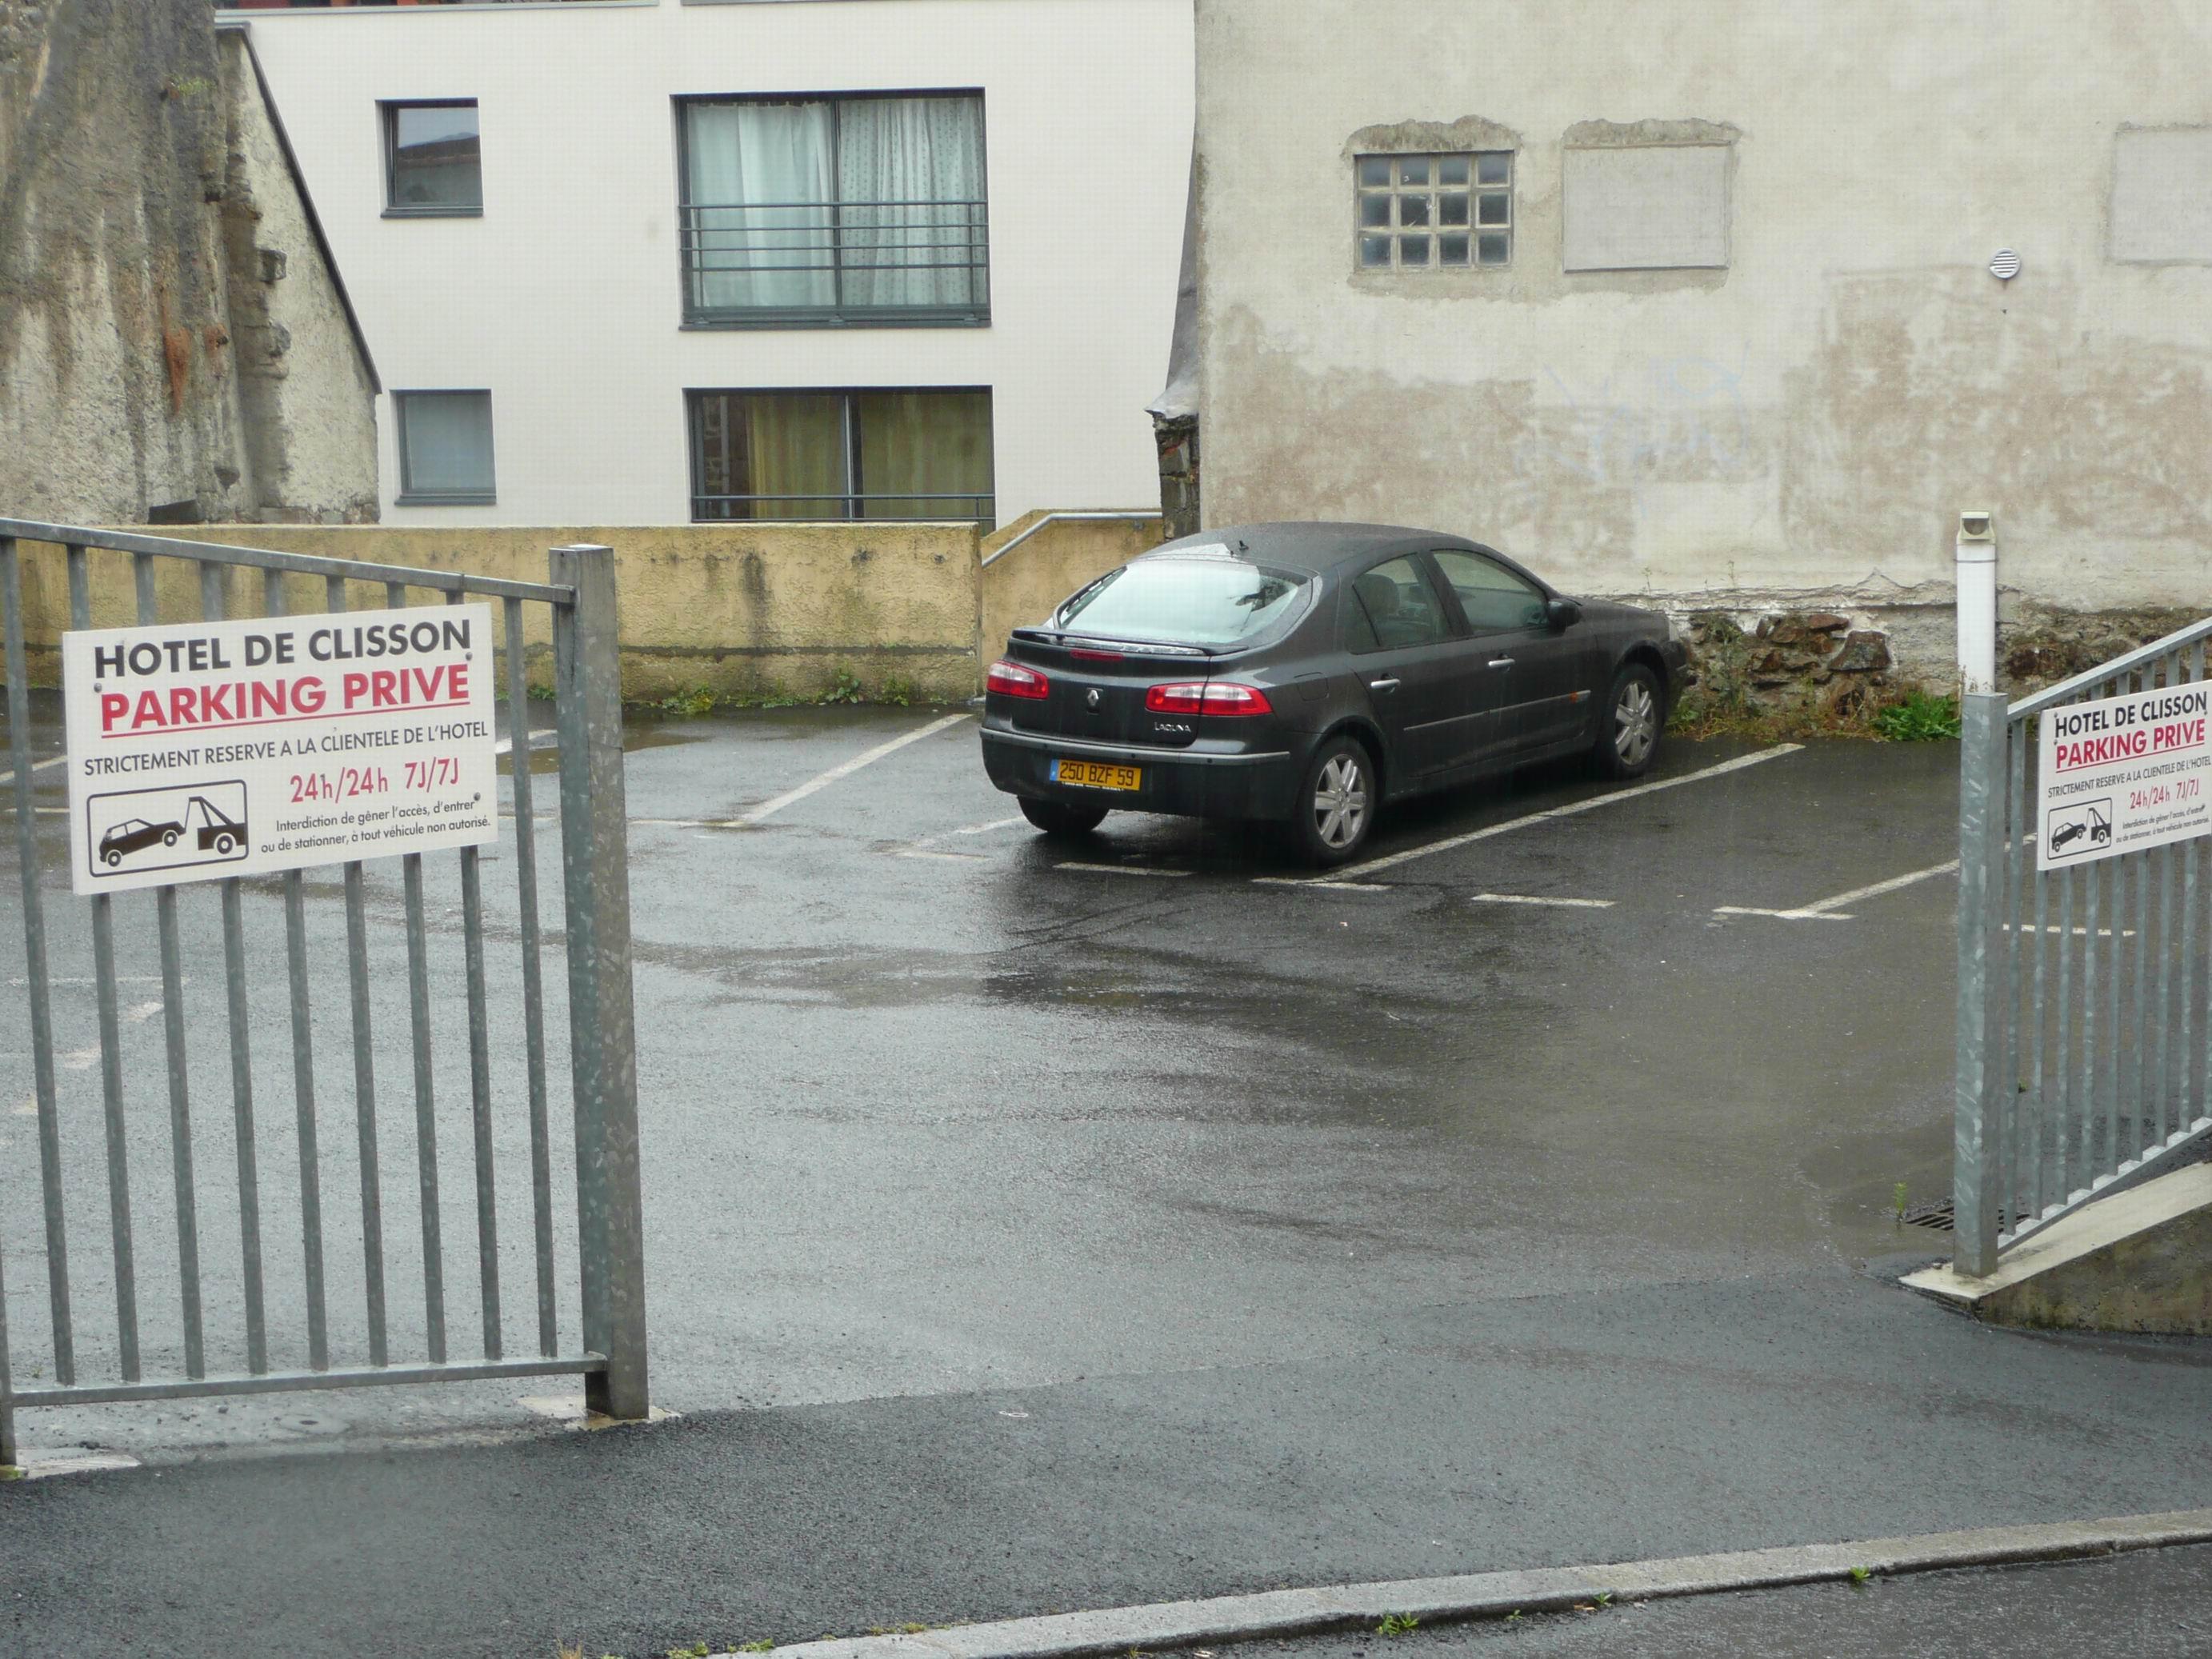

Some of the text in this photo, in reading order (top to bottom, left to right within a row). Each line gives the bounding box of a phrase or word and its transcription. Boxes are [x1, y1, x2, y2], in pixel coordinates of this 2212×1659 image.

[94, 619, 470, 678] HOTEL DE CLISSON
[102, 664, 470, 731] PARKING PRIVE
[2054, 691, 2207, 738] HOTEL DE CLISSON
[84, 721, 488, 776] STRICTEMENT RESERVE A LA CLIENTELE DE L'HOTEL
[1154, 722, 1191, 732] LAGUNA
[2056, 718, 2205, 769] PARKING PRIVE
[290, 757, 459, 803] 24h/24h 7J/7J
[1060, 762, 1085, 781] 250
[1089, 765, 1114, 784] BZF
[1117, 768, 1134, 786] 59
[2048, 755, 2211, 798] STRICTEMENT RESERVE A LA CLIENTELE DE L'HOTEL
[2130, 778, 2199, 810] 24h/24h 7J/7J
[276, 800, 475, 832] Interdiction de gêner l'accès, d'entrer
[278, 837, 291, 851] de
[294, 835, 350, 849] stationner,
[351, 831, 358, 842] à
[361, 829, 381, 841] tout
[383, 824, 424, 838] véhicule
[426, 824, 446, 833] non
[448, 815, 491, 830] autorisé.
